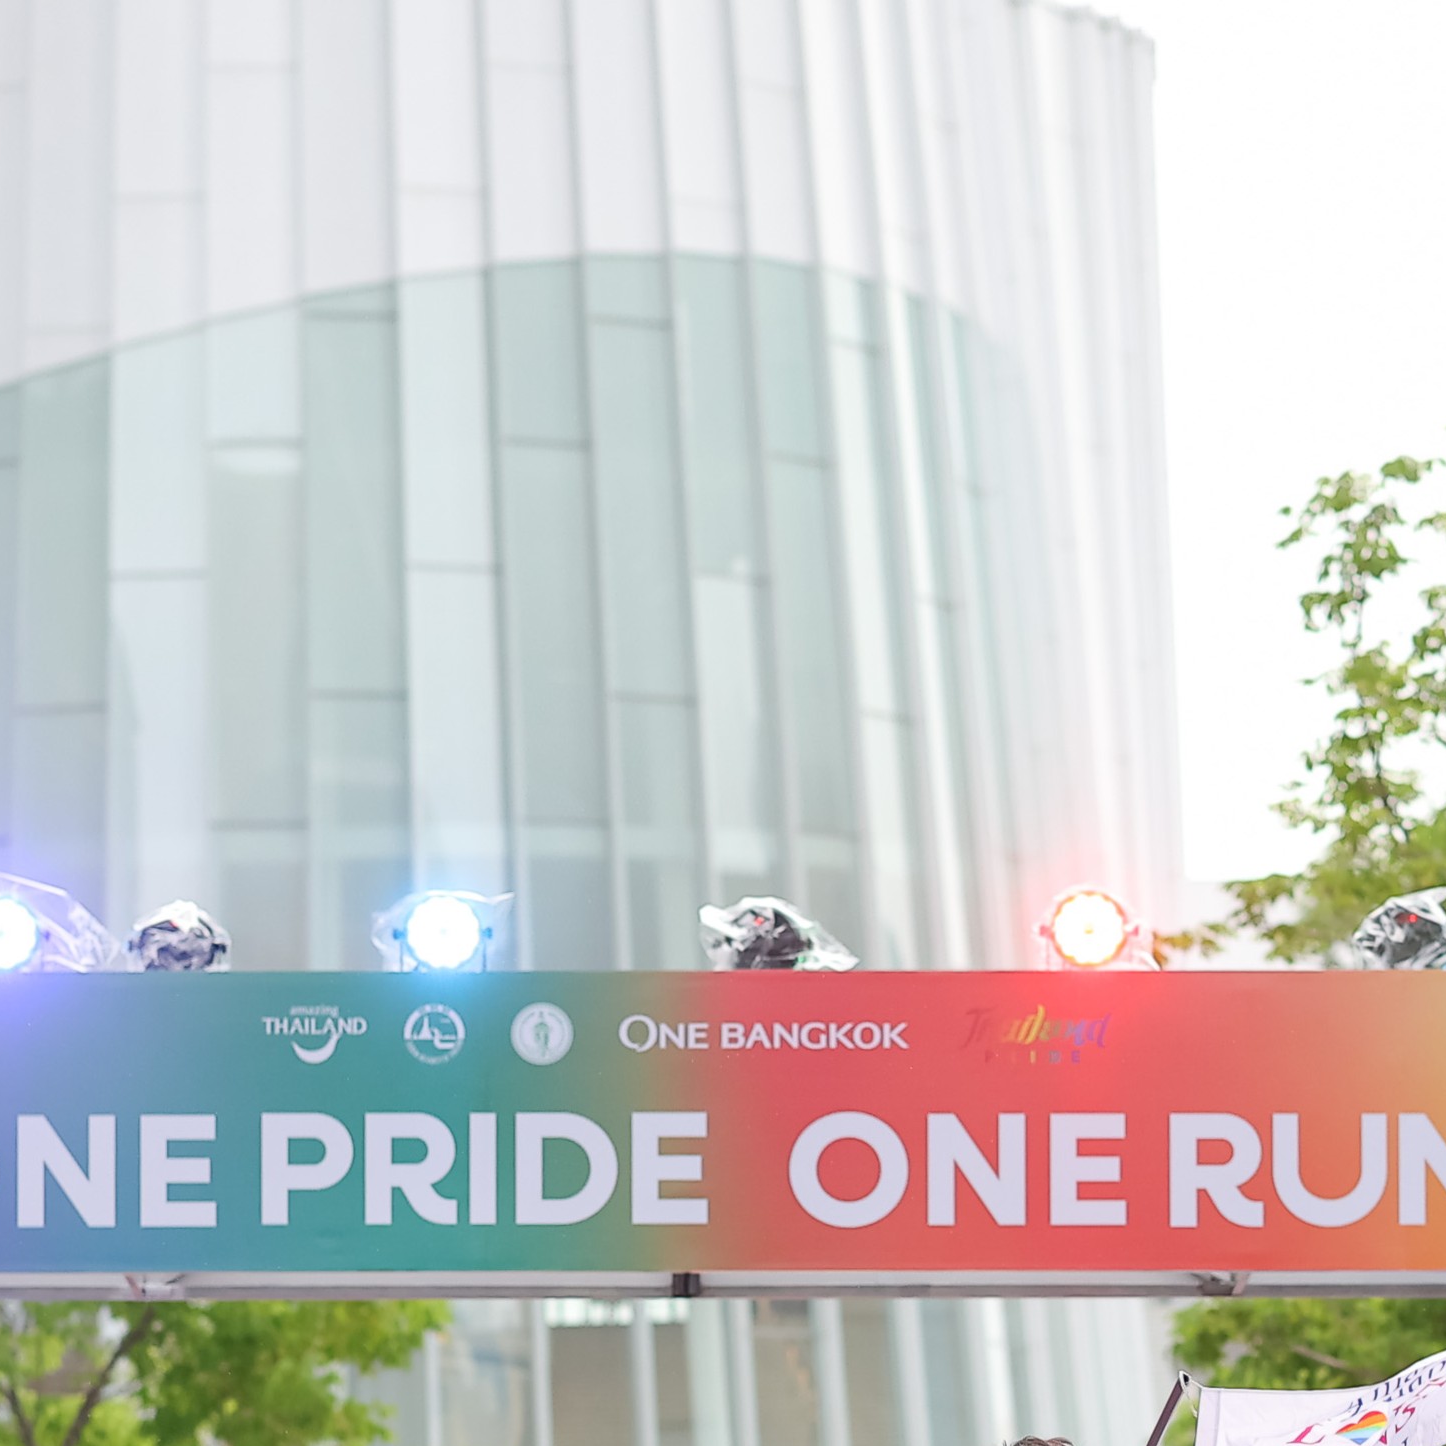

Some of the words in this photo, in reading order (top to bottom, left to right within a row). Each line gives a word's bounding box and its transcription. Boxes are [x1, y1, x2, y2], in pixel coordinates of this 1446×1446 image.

[262, 1016, 368, 1036] THAILAND
[618, 1014, 709, 1052] ONE
[720, 1022, 909, 1050] BANGKOK
[261, 1112, 709, 1226] PRIDE
[788, 1110, 1127, 1228] ONE
